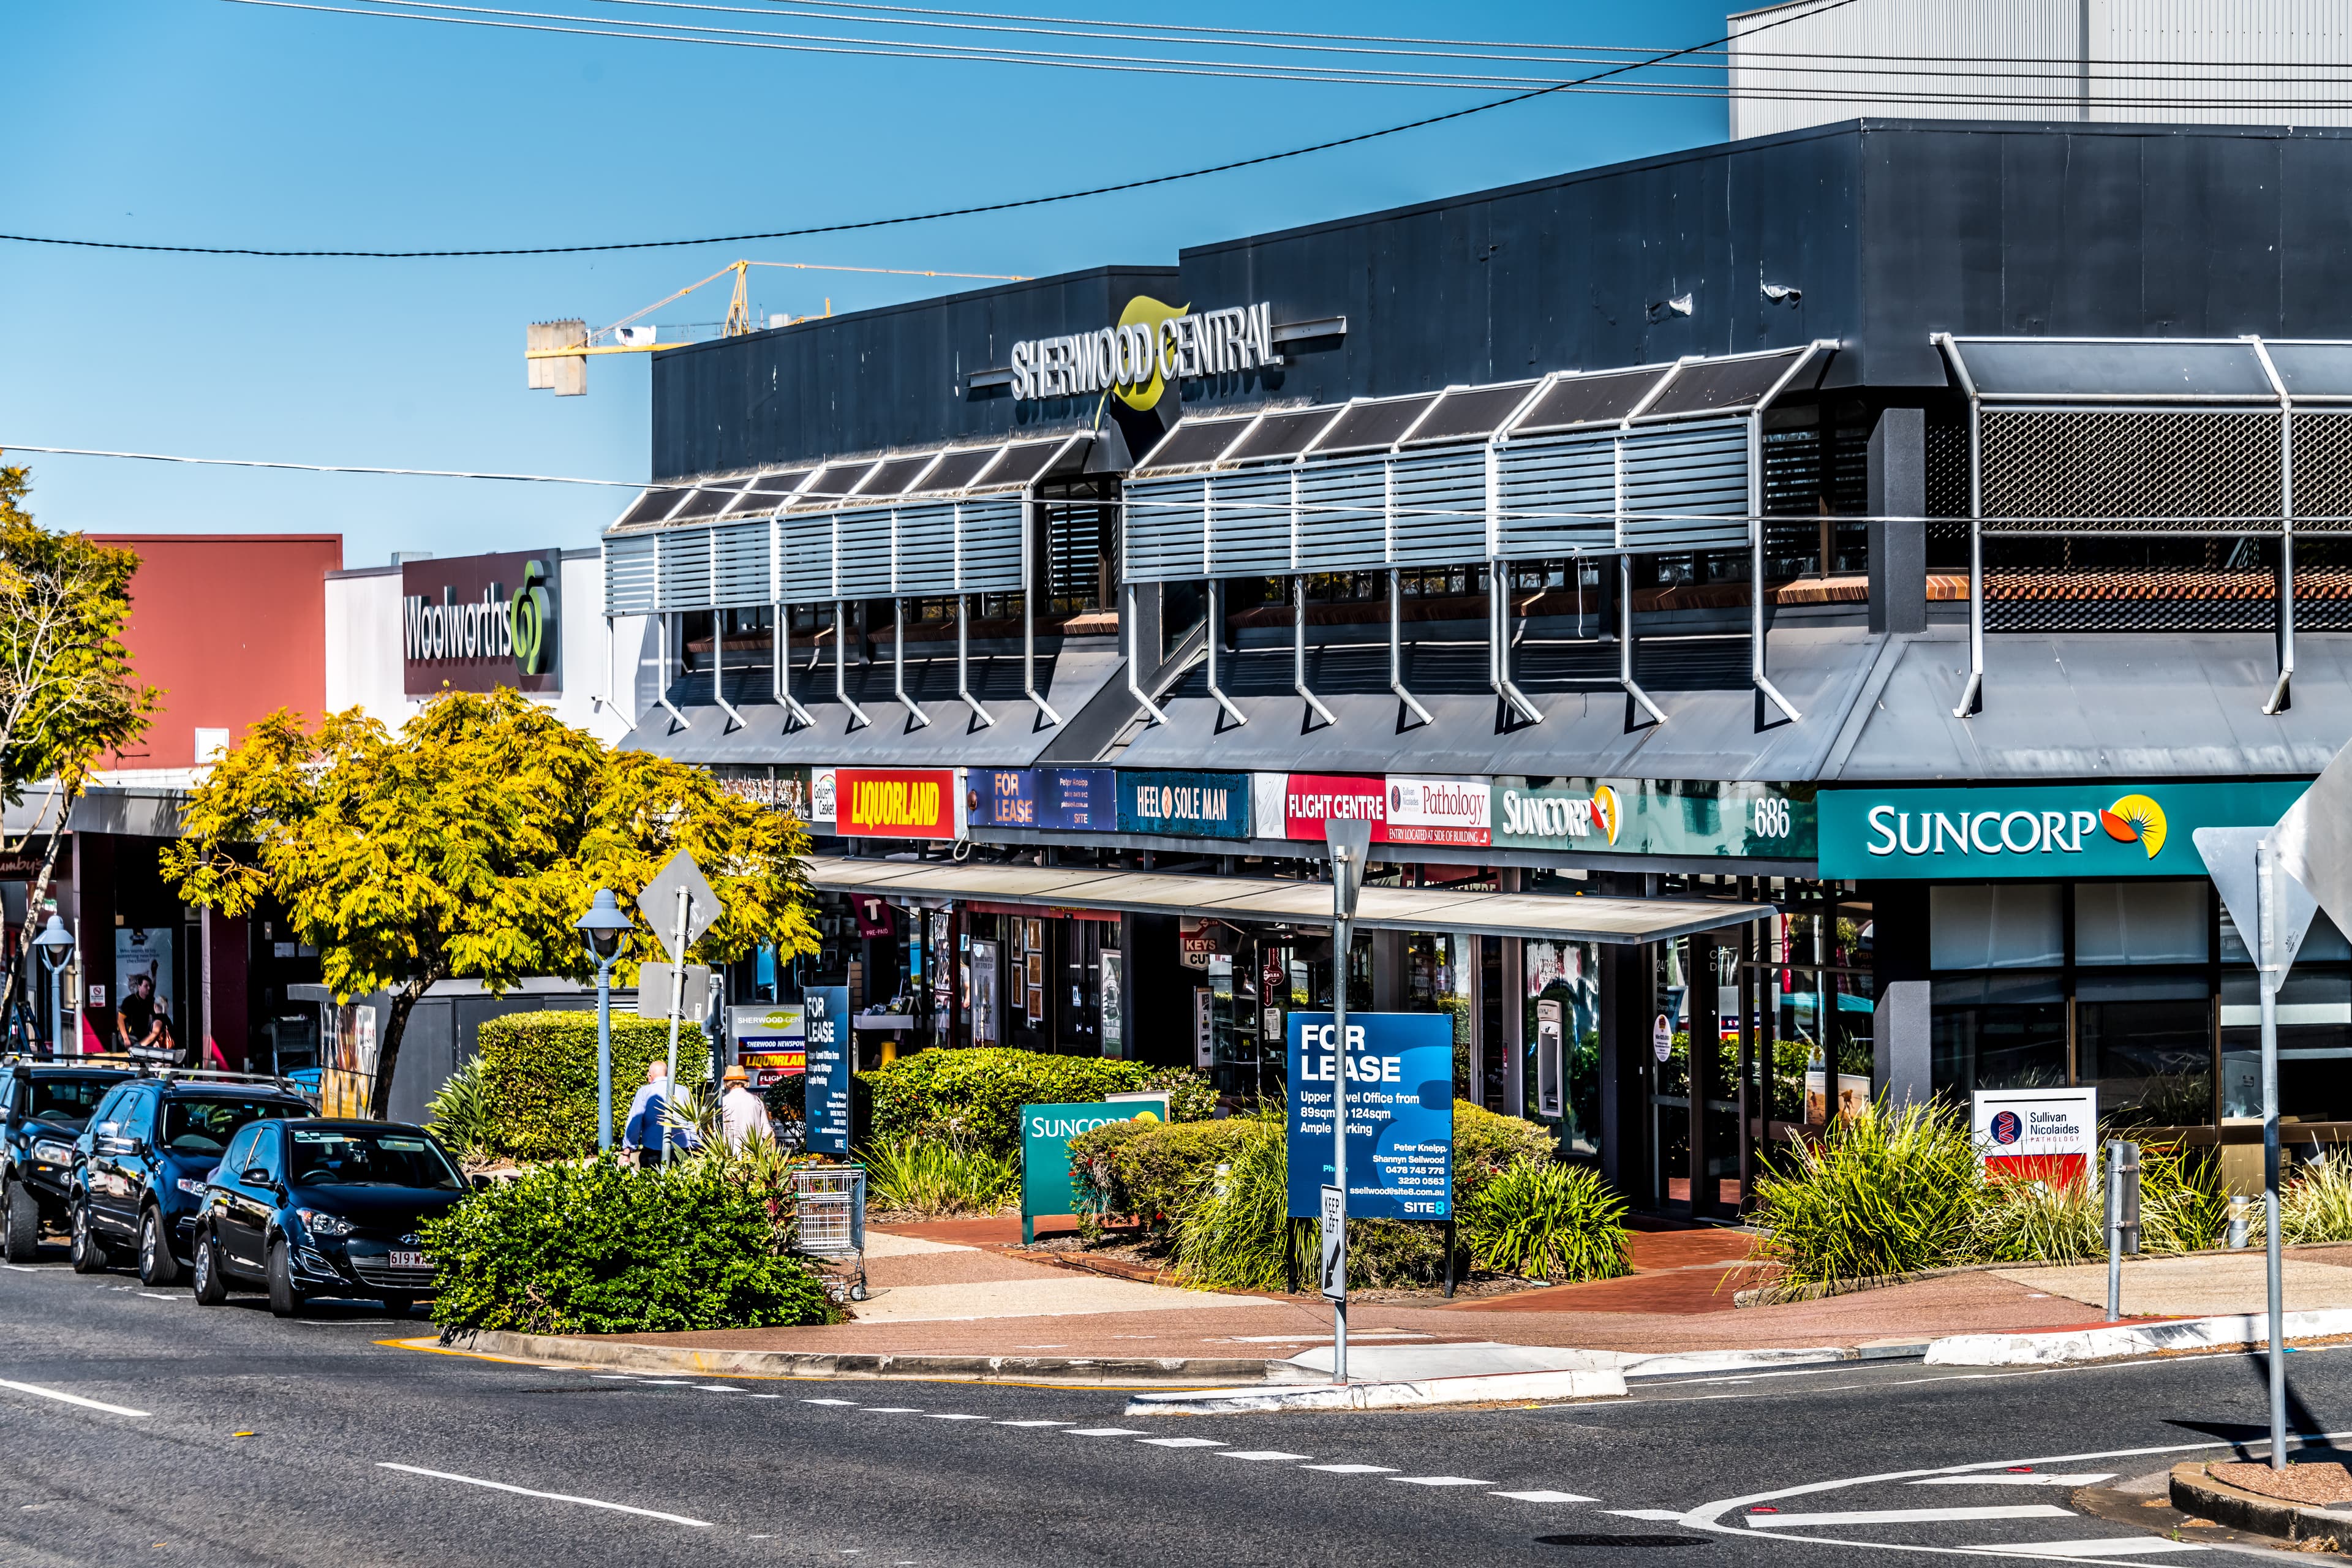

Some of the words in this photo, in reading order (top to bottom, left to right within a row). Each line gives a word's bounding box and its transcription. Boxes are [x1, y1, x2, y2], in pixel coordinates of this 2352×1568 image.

[1011, 322, 1155, 401] SHERWOOD
[1158, 301, 1284, 380] CENTRAL
[404, 582, 513, 660] Woolworths
[814, 784, 831, 799] Golden
[995, 773, 1019, 796] FOR
[819, 801, 835, 815] Casket
[851, 780, 940, 831] LIQUORLAND
[995, 798, 1033, 823] LEASE
[1137, 786, 1161, 818] HEEL
[1175, 786, 1200, 819] SOLE
[1202, 789, 1227, 821] MAN
[1288, 793, 1332, 819] FLIGHT
[1333, 794, 1384, 820] CENTRE
[1422, 785, 1485, 825] Pathology
[1503, 790, 1591, 837] SUNCORP
[1755, 797, 1790, 839] 686
[1389, 828, 1404, 839] ENTRY
[1404, 829, 1427, 840] LOCATED
[1427, 830, 1433, 841] AT
[1434, 830, 1445, 842] SIDE
[1446, 831, 1453, 842] OF
[1453, 831, 1478, 843] BUILDING
[1867, 805, 2097, 856] SUNCORP
[1186, 940, 1216, 950] KEYS
[807, 997, 824, 1018] FOR
[807, 1021, 834, 1042] LEASE
[1301, 1024, 1365, 1050] FOR
[1301, 1055, 1401, 1082] LEASE
[1300, 1091, 1332, 1103] Upper
[1363, 1092, 1393, 1103] Office
[1395, 1093, 1420, 1104] from
[1300, 1107, 1335, 1120] 89sqm
[1351, 1109, 1391, 1121] 124sqm
[2030, 1112, 2067, 1123] Sullivan
[1300, 1122, 1332, 1135] Ample
[2030, 1124, 2079, 1135] Nicolaides
[1373, 1155, 1407, 1164] Shannyn
[1408, 1155, 1445, 1164] Sellwood
[1349, 1186, 1445, 1196] ssellwood@site8.com.au
[1325, 1196, 1340, 1215] KEEP
[1404, 1200, 1445, 1215] SITE8
[1325, 1215, 1339, 1235] LEFT
